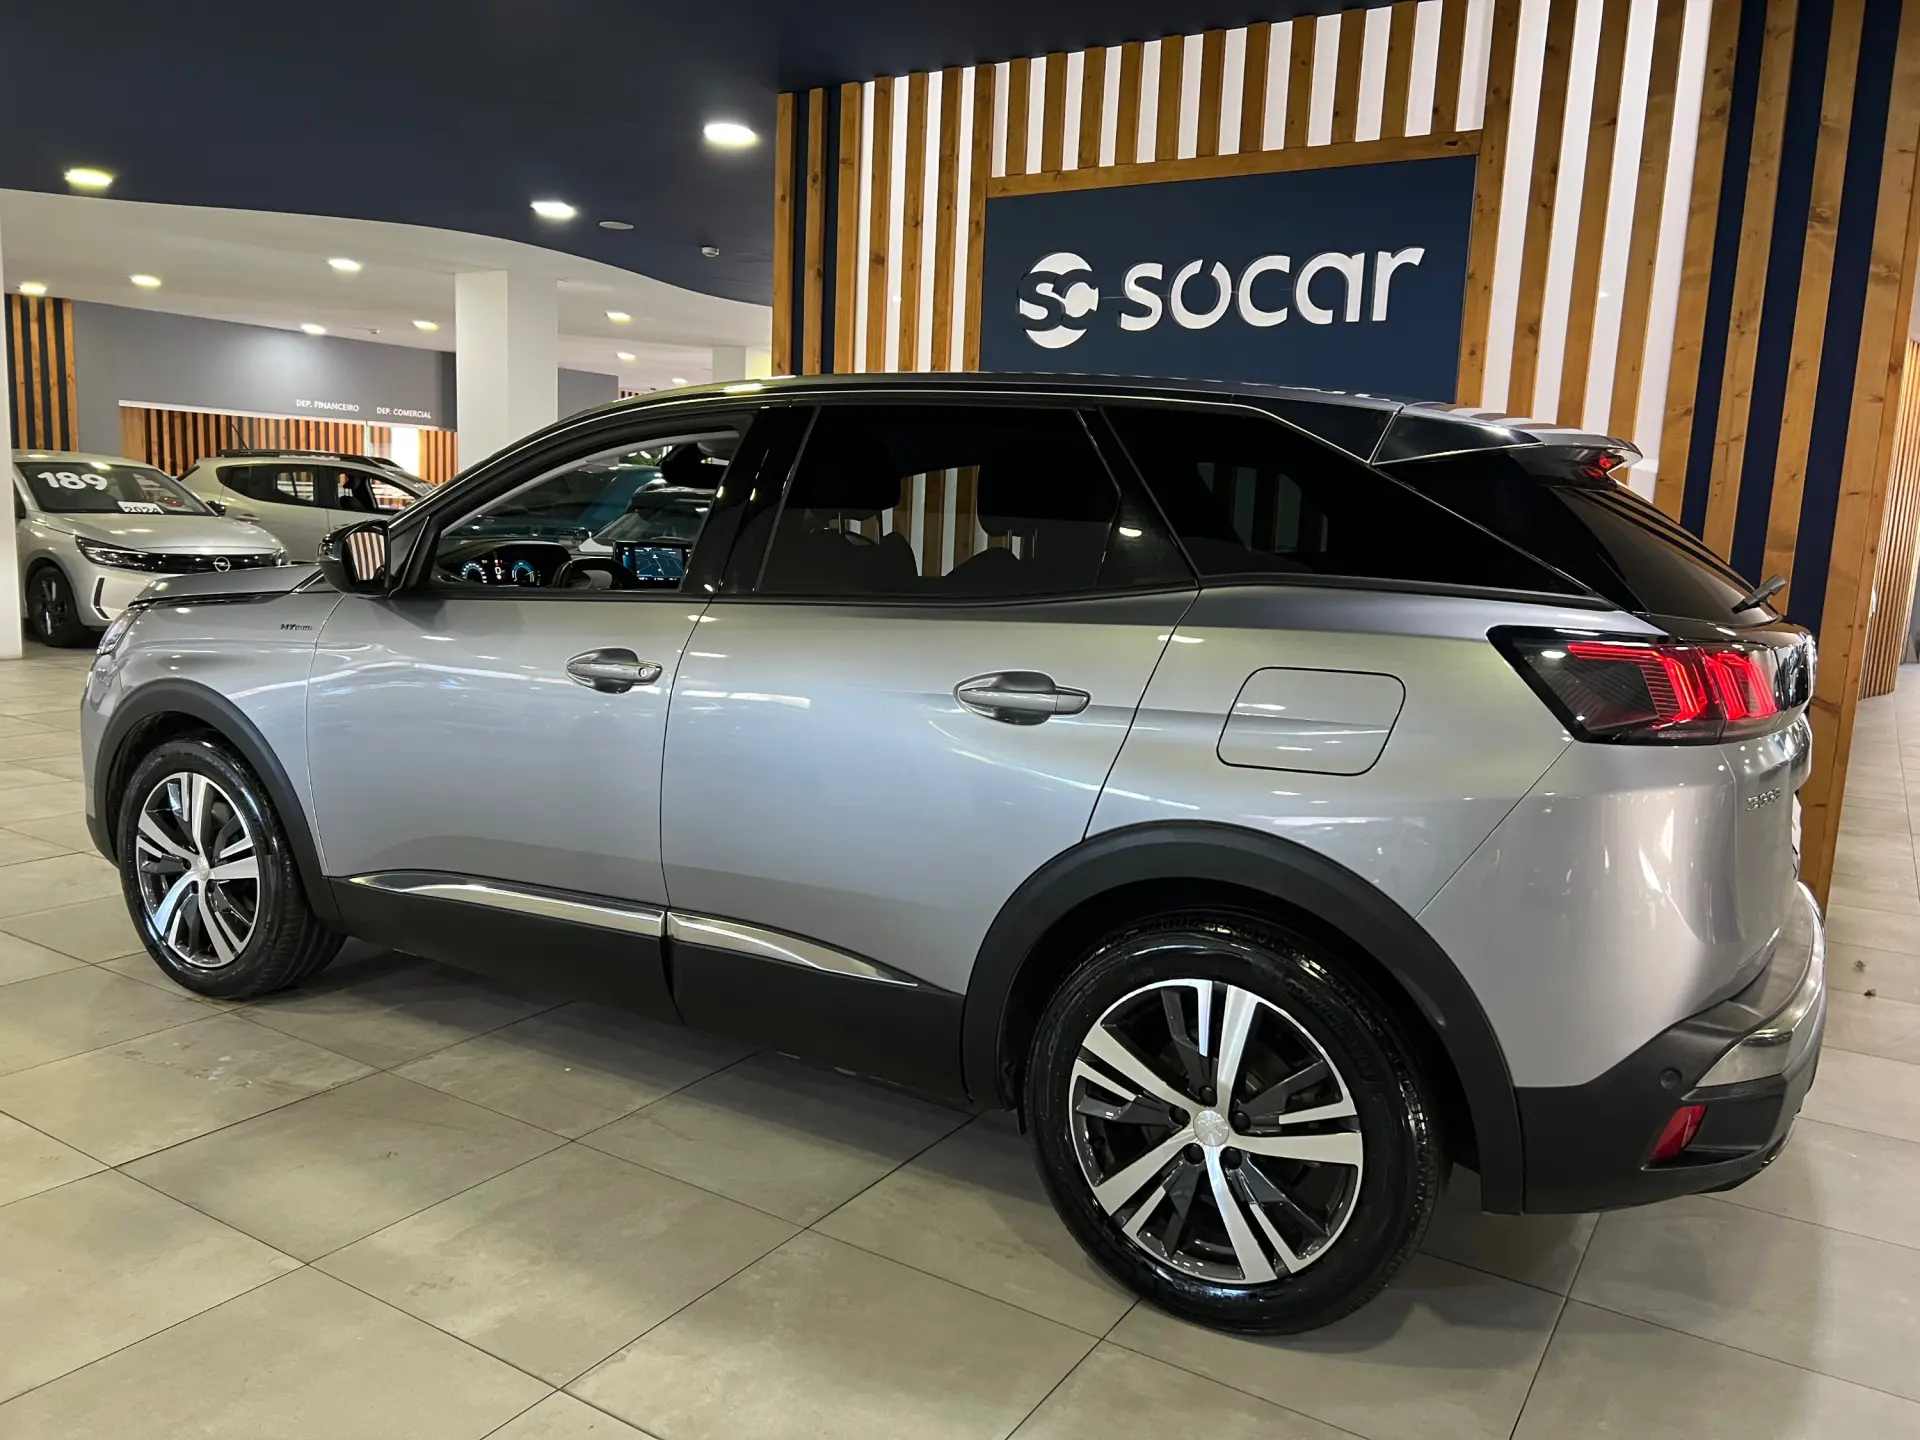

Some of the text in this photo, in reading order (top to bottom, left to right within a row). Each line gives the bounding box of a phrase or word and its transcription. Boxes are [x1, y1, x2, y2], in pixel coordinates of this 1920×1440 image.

[296, 399, 360, 412] DEP. FINANCEIRO
[376, 407, 432, 419] DEP. COMERCIAL
[37, 471, 108, 491] 189
